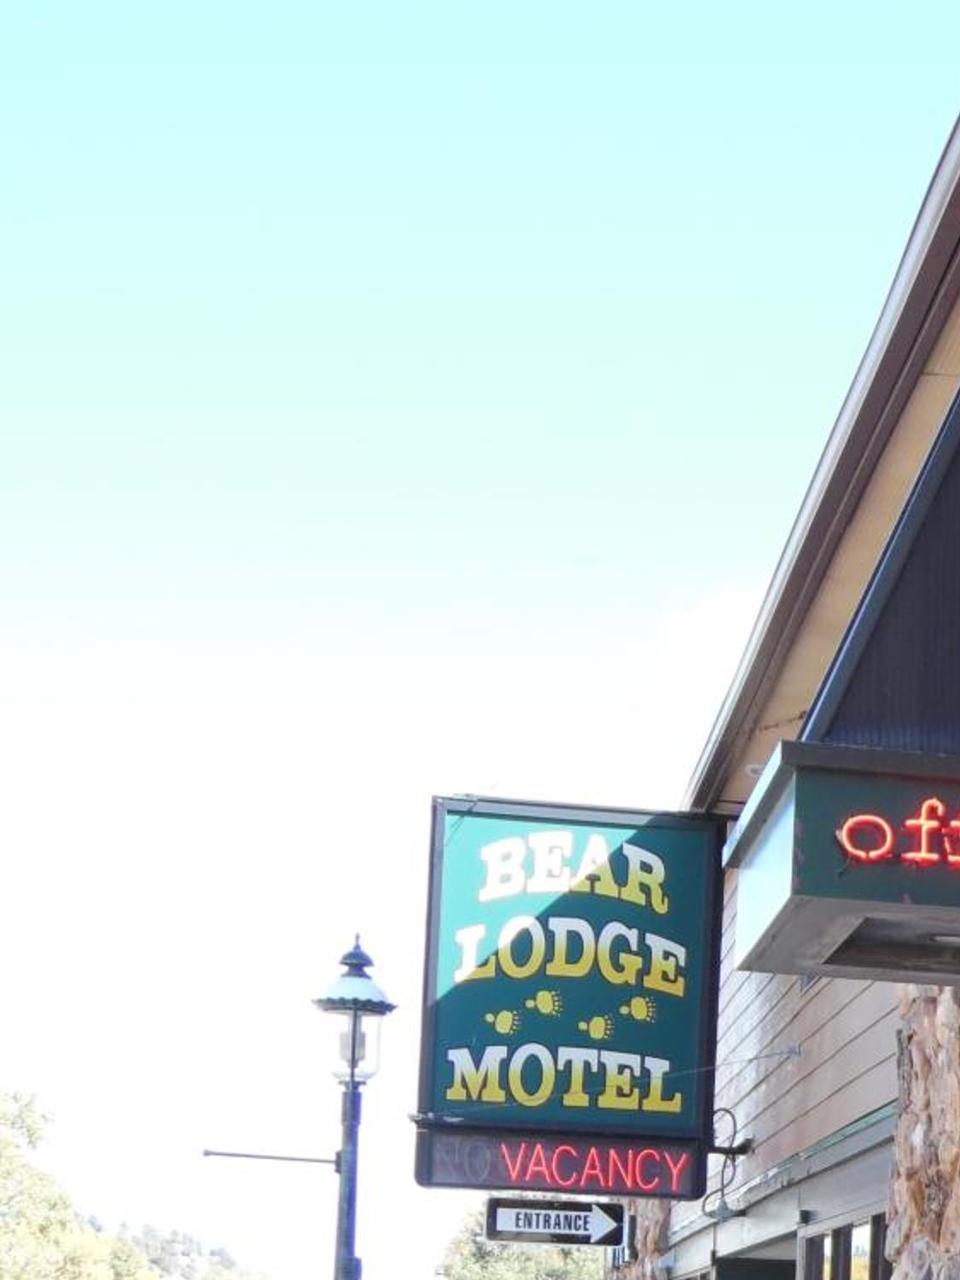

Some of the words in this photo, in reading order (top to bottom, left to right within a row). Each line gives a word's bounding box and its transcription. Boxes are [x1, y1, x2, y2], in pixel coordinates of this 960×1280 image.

[479, 831, 669, 914] BEAR
[454, 915, 686, 997] LODGE
[446, 1042, 682, 1113] MOTEL
[500, 1142, 691, 1191] VACANCY
[514, 1210, 591, 1232] ENTRANCE
